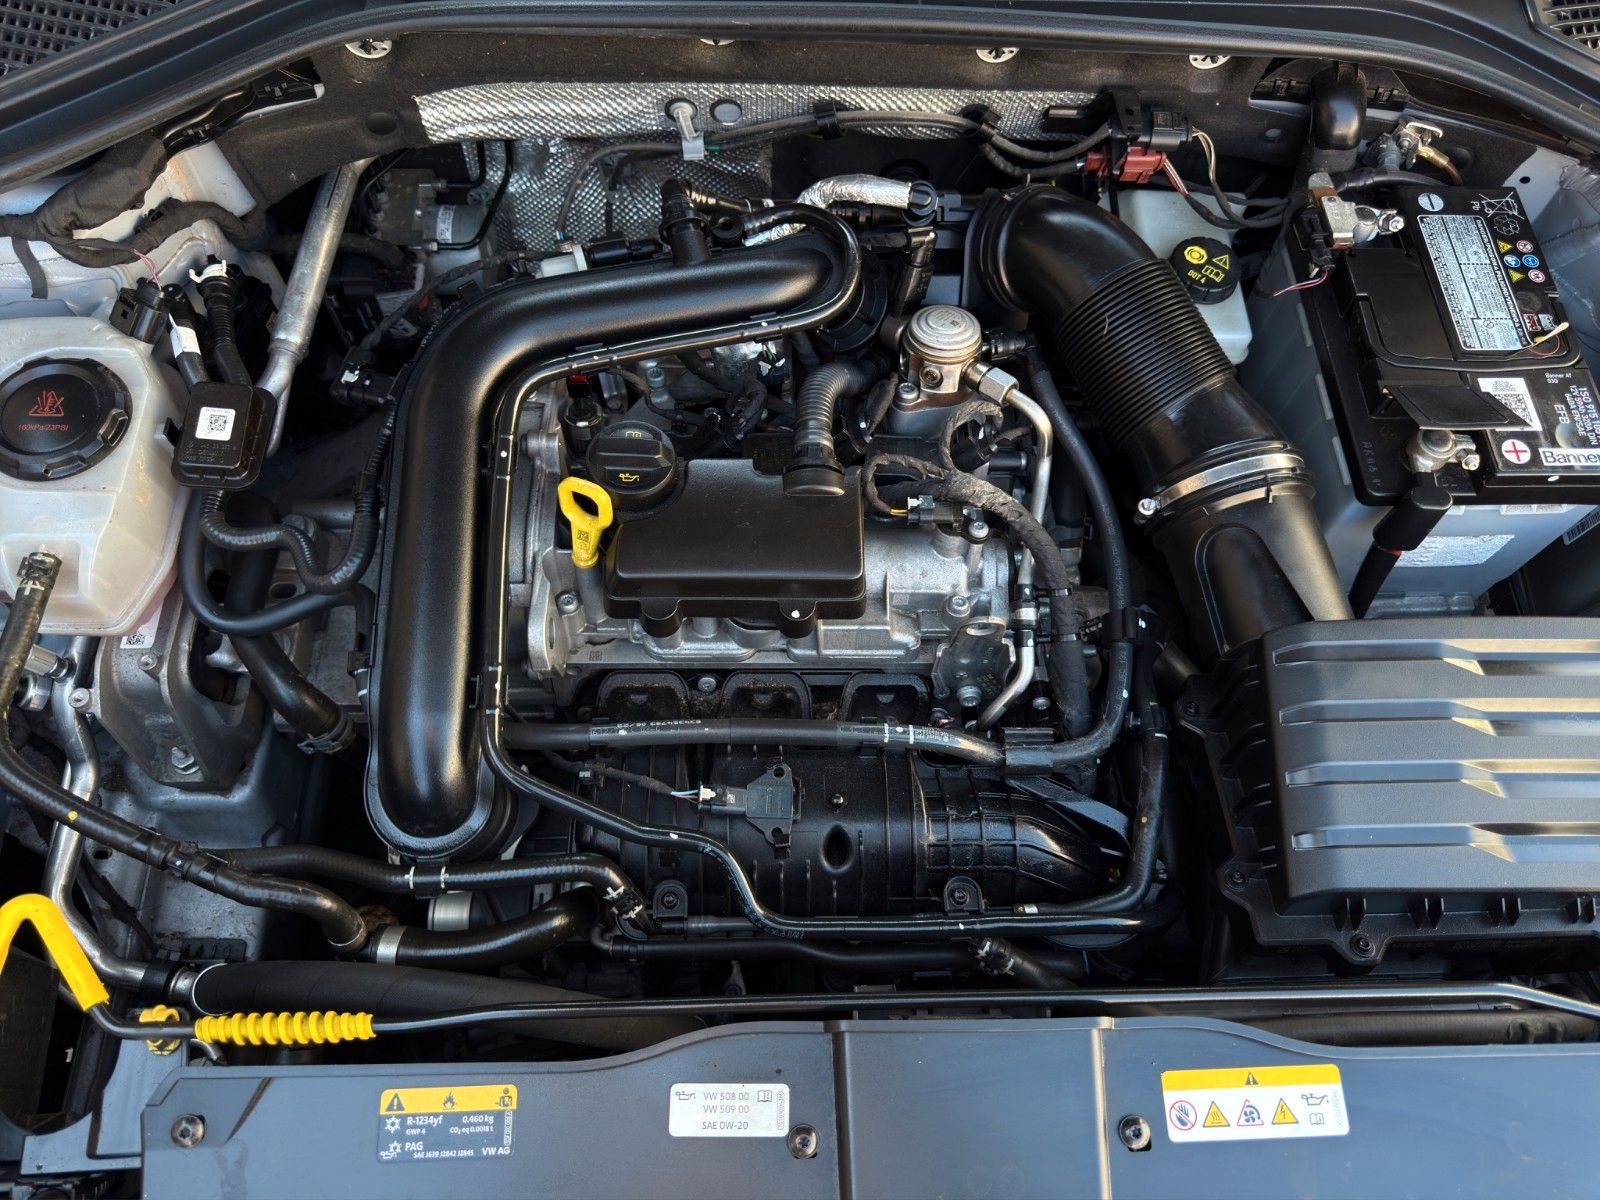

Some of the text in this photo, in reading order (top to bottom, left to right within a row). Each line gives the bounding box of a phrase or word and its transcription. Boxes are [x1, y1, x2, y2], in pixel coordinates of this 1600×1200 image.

[1470, 201, 1482, 210] Pb
[1188, 270, 1202, 280] DOT
[1554, 404, 1570, 425] EFB
[1570, 385, 1580, 396] 12V
[1587, 432, 1598, 446] DIN
[1572, 410, 1586, 436] EN/SAE
[704, 1092, 750, 1100] VW 508 00
[703, 1105, 750, 1113] VW 509 00
[407, 1115, 494, 1128] R-1234yf 0.460 kg
[702, 1121, 748, 1130] SAE 0W-20
[404, 1142, 424, 1151] PAG
[482, 1147, 497, 1155] VW
[497, 1146, 510, 1154] AG
